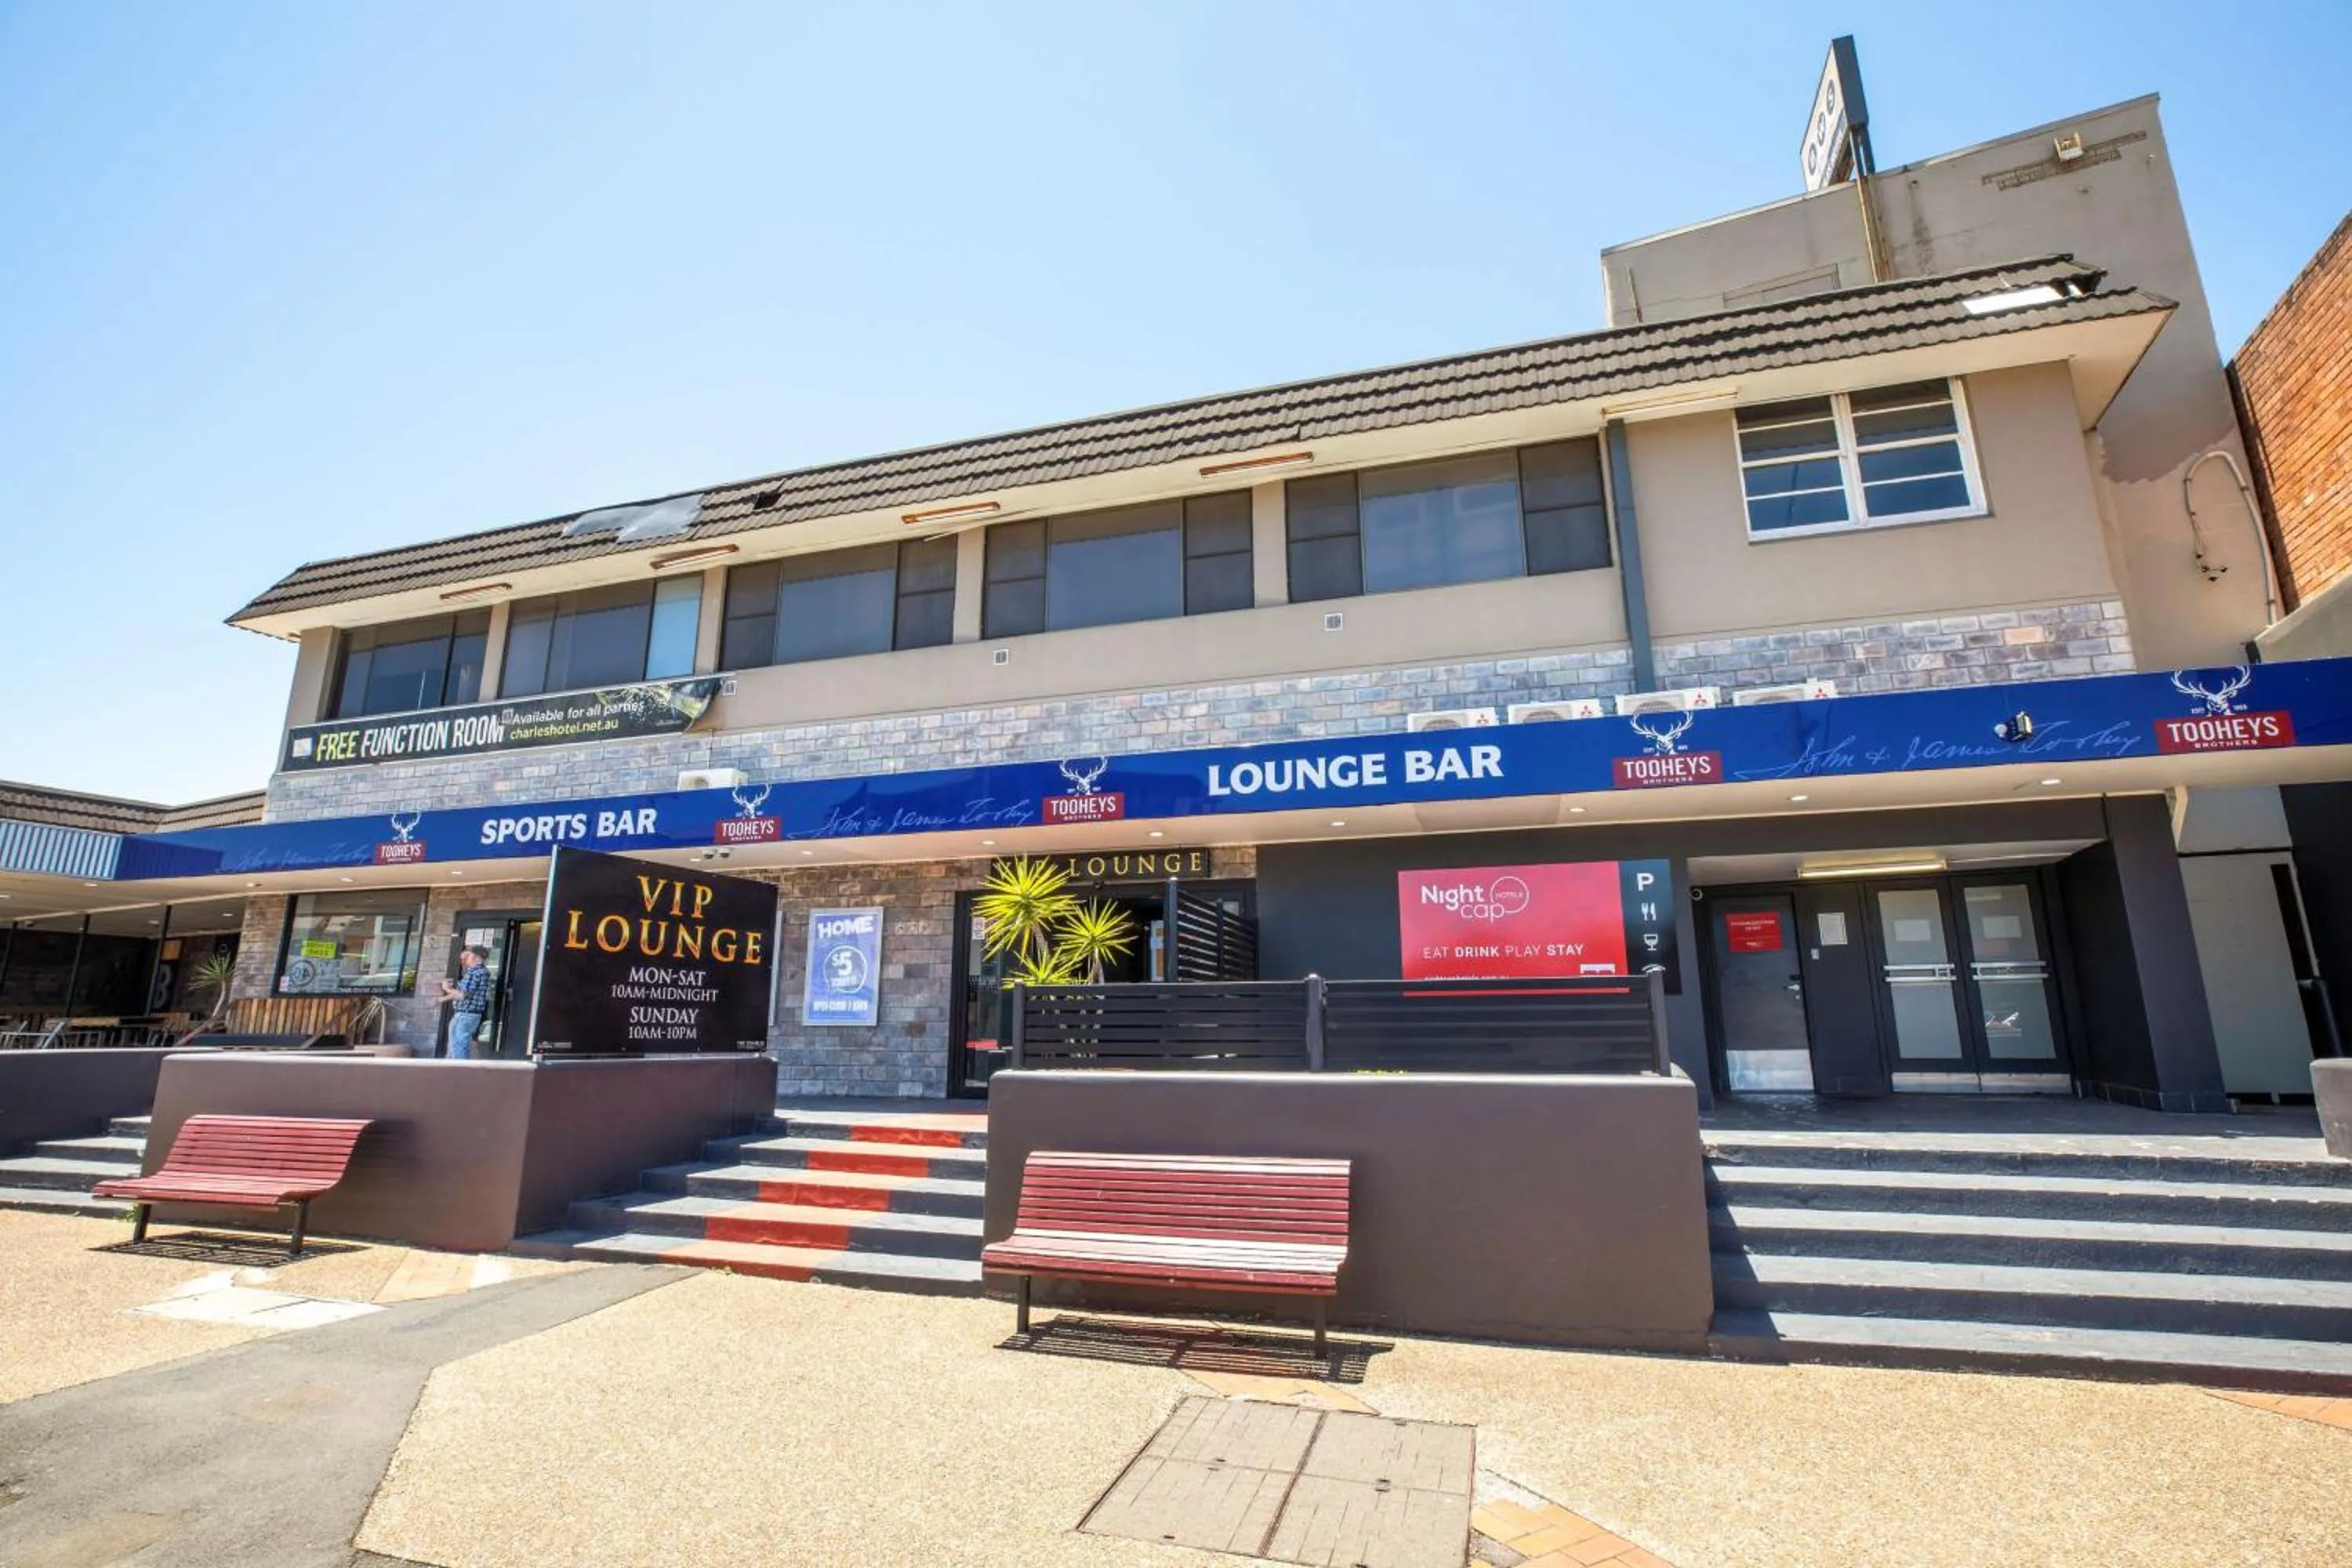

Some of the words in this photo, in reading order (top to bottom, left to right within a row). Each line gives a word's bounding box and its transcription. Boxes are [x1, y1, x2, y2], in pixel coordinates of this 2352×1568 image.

[512, 708, 564, 725] Available
[567, 706, 583, 719] for
[586, 703, 601, 717] all
[316, 731, 360, 761] FREE
[361, 720, 449, 757] FUNCTION
[452, 714, 504, 747] ROOM
[510, 718, 619, 739] charleshotel.net.au
[2166, 717, 2279, 742] TOOHEYS
[2194, 739, 2258, 748] BROTHERS
[1208, 753, 1387, 796] LOUNGE
[1405, 745, 1504, 783] BAR
[1623, 756, 1711, 778] TOOHEYS
[1051, 797, 1116, 815] TOOHEYS
[481, 813, 587, 844] SPORTS
[597, 808, 657, 837] BAR
[722, 819, 775, 837] TOOHEYS
[381, 843, 422, 858] TOOHEYS
[1070, 852, 1203, 877] LOUNGE
[1636, 873, 1653, 891] P
[637, 875, 713, 919] VIP
[1421, 884, 1484, 911] Night
[1461, 902, 1504, 923] cap
[564, 909, 763, 964] LOUNGE
[817, 916, 874, 939] HOME
[1423, 946, 1450, 959] EAT
[1455, 946, 1500, 958] DRINK
[1505, 944, 1542, 957] PLAY
[1547, 943, 1584, 956] STAY
[628, 967, 706, 986] MON-SAT
[611, 984, 719, 1003] 10AM-MIDNIGHT
[630, 1006, 699, 1024] SUNDAY
[628, 1026, 697, 1040] 10AM-10PM
